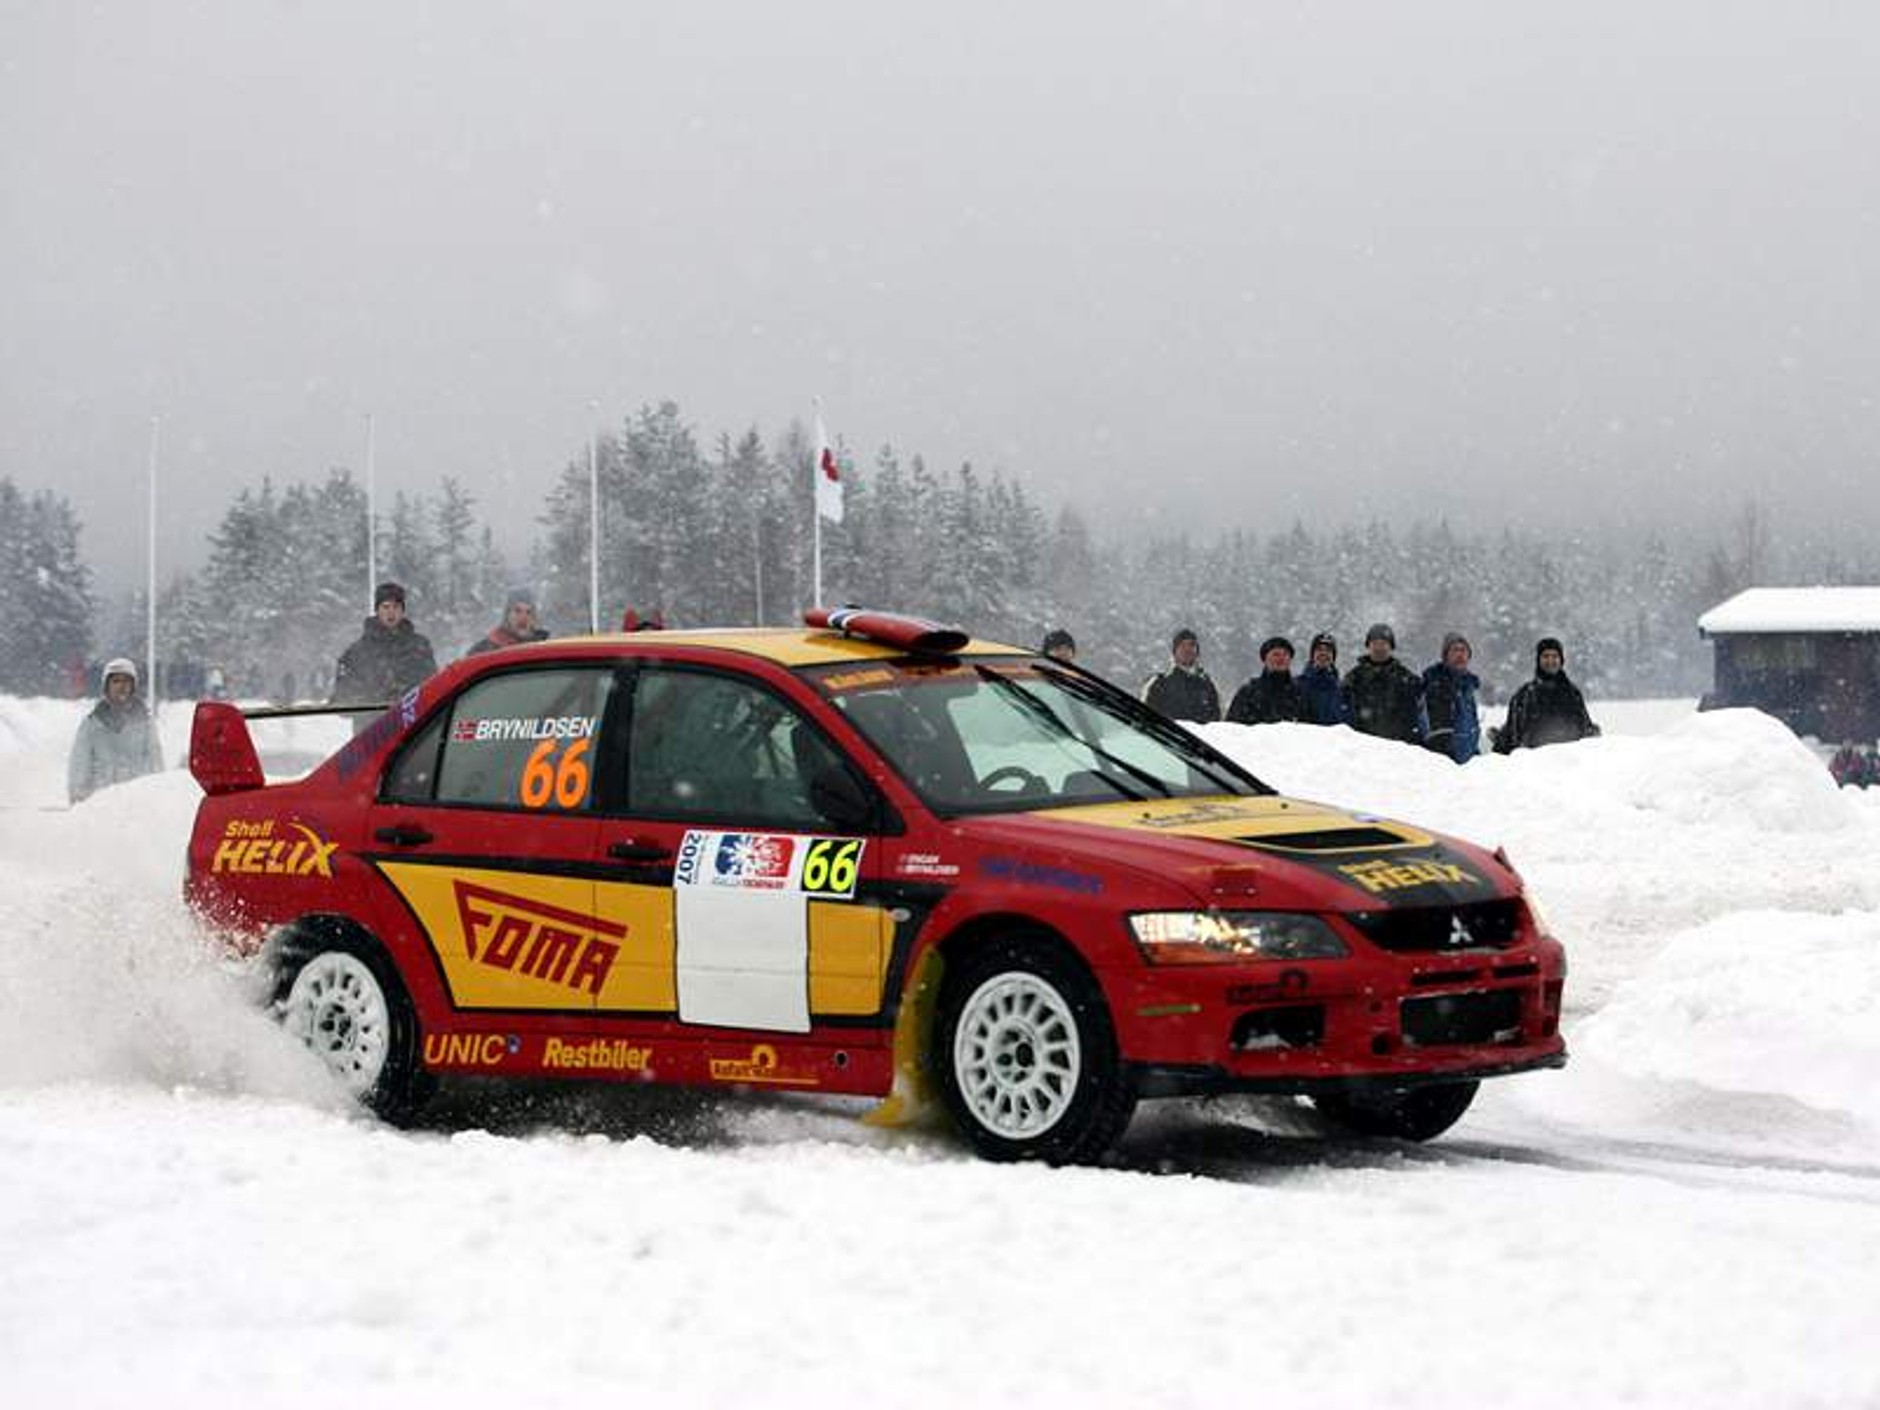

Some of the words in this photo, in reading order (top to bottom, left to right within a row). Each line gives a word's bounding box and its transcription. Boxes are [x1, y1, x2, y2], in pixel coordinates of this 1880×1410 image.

[476, 716, 596, 740] BRYNILDSEN
[521, 738, 589, 808] 66
[225, 819, 275, 837] Shell
[212, 823, 340, 878] HELIX
[677, 833, 701, 885] 2007
[803, 840, 857, 892] 66
[1354, 863, 1481, 892] HELIX
[453, 879, 628, 995] FOMA
[424, 1034, 505, 1064] UNIC
[542, 1037, 653, 1069] Restbiler
